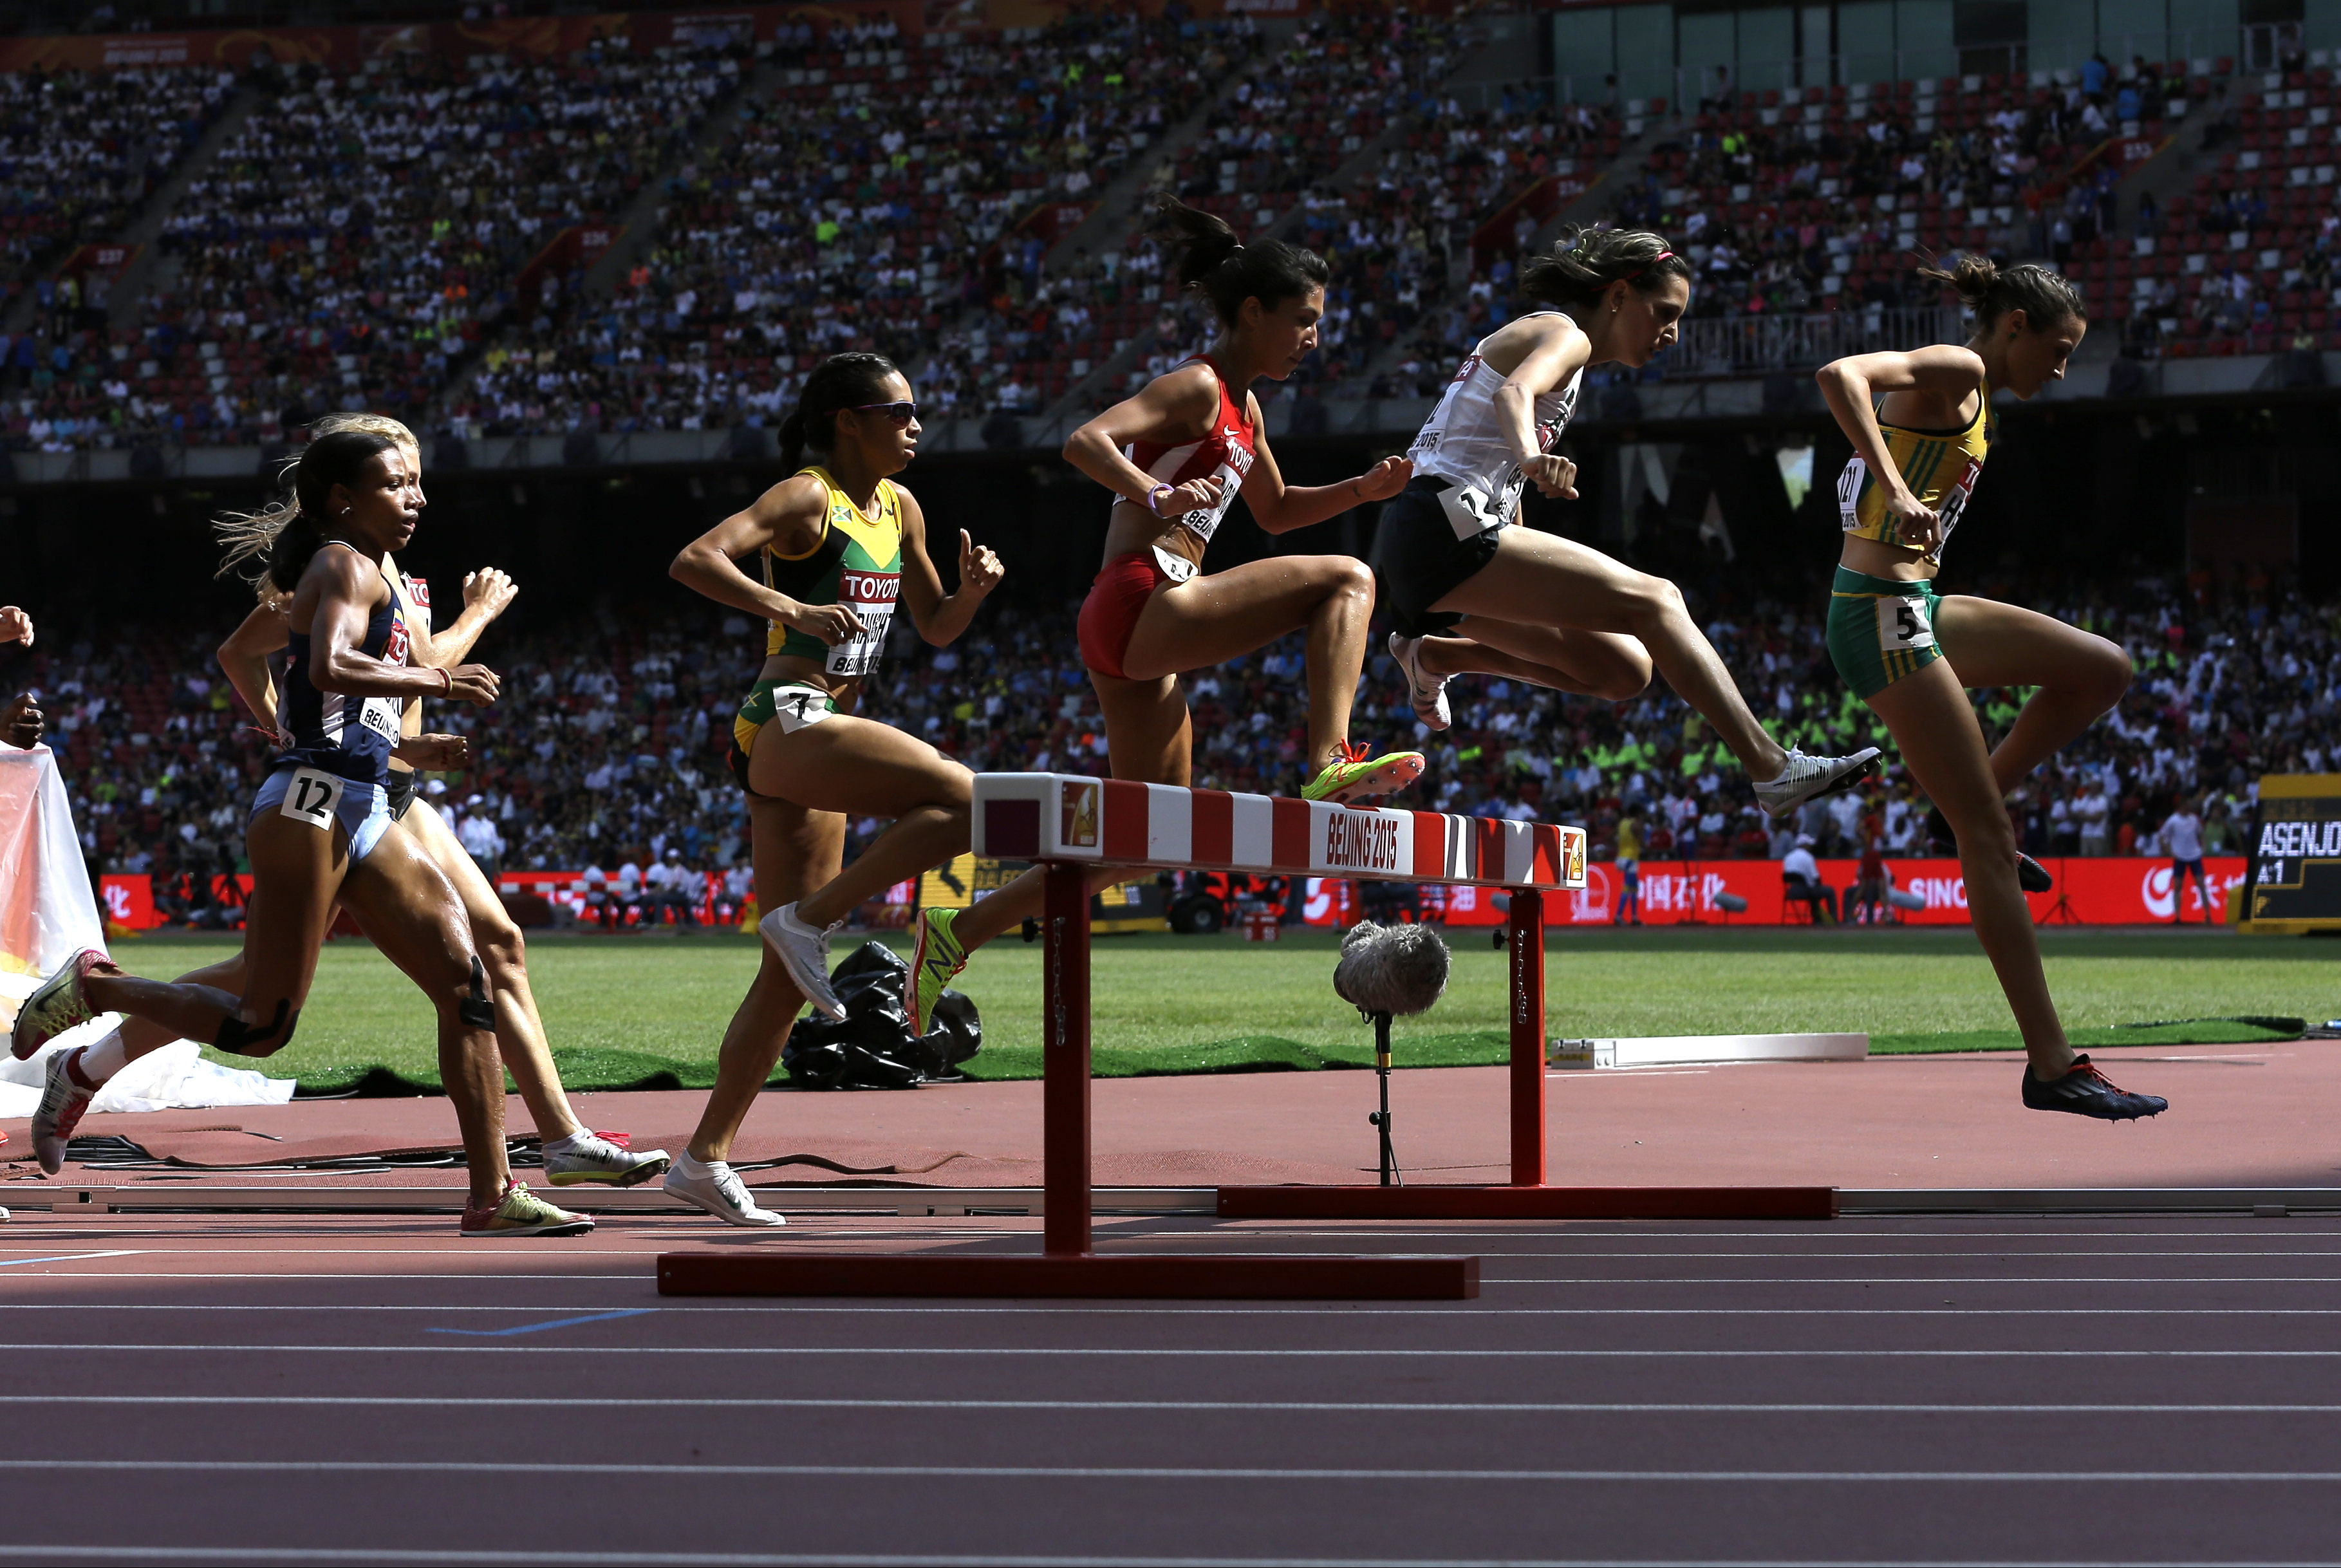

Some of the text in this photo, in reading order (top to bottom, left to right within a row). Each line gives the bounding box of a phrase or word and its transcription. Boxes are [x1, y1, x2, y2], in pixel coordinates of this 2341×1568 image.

[1230, 442, 1254, 477] TOYO
[1896, 606, 1917, 640] 5
[788, 692, 811, 720] 7
[294, 776, 333, 819] 12
[1327, 812, 1398, 870] BEIJING 2015
